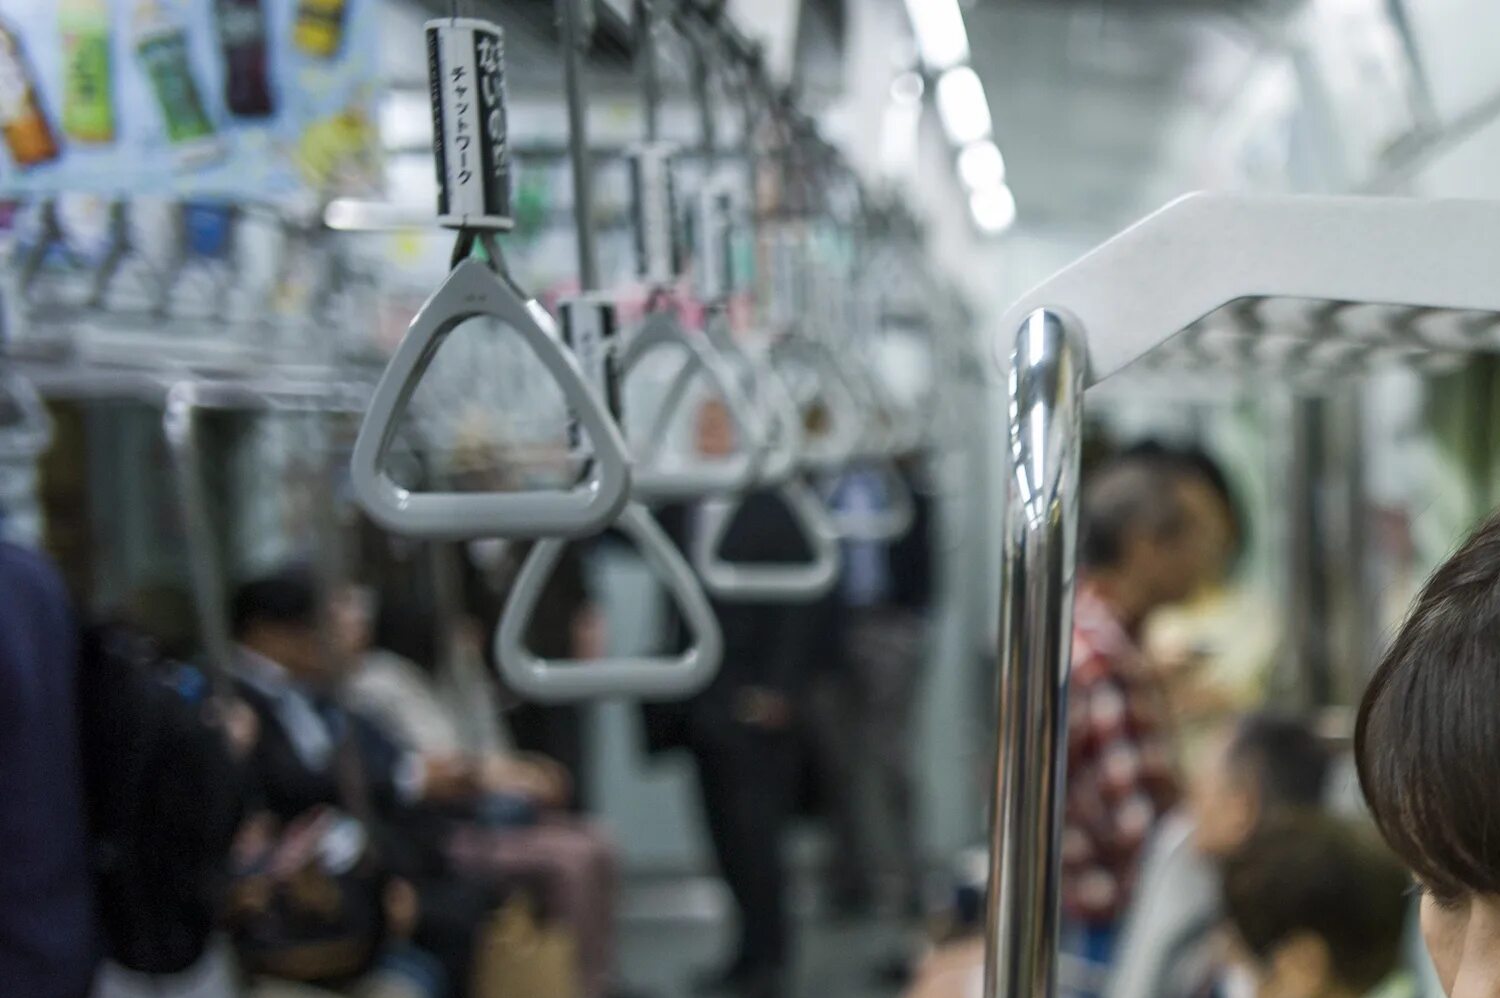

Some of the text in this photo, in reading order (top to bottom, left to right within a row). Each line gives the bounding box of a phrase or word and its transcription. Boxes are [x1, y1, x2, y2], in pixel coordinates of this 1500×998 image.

[450, 65, 473, 185] チャットワーク
